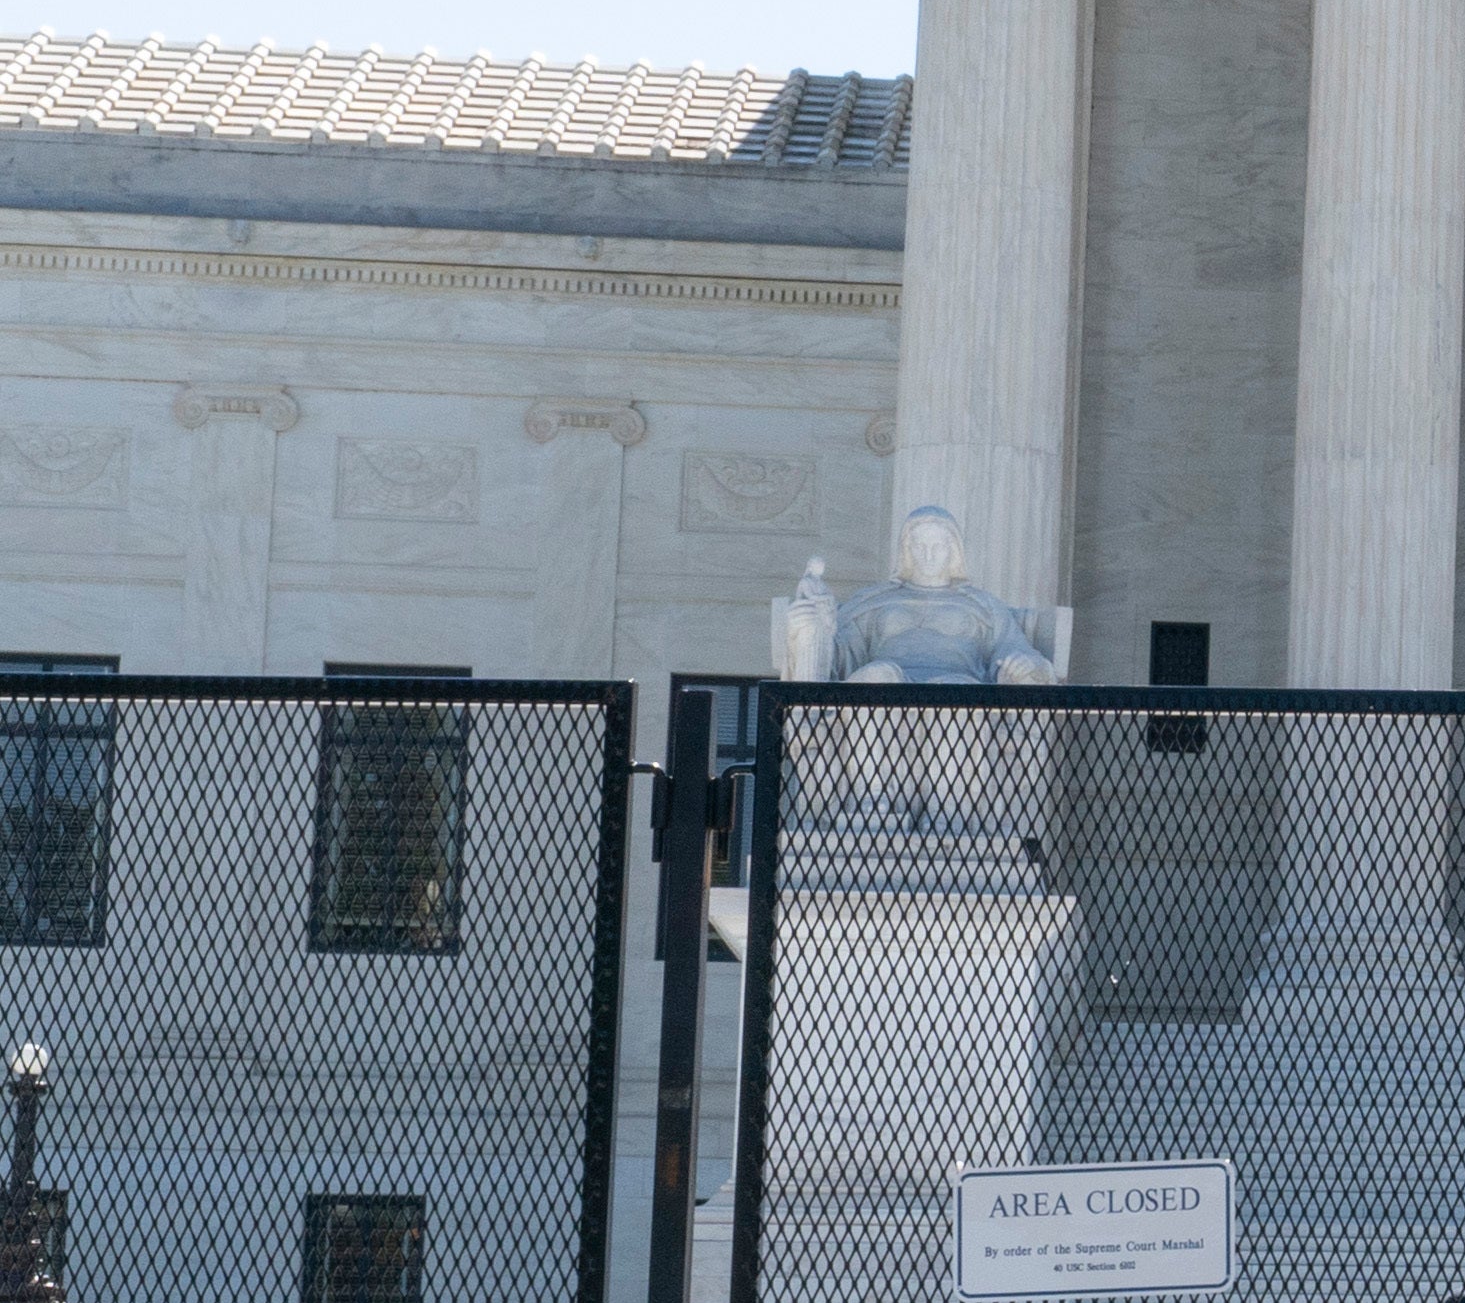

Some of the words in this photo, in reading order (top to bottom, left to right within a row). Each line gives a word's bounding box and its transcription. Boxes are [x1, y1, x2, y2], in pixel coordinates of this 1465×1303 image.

[988, 1191, 1073, 1219] AREA
[1086, 1186, 1201, 1215] CLOSED
[984, 1245, 999, 1259] By
[1003, 1245, 1032, 1257] order
[1036, 1243, 1049, 1255] of
[1054, 1243, 1071, 1255] the
[1075, 1242, 1122, 1256] Supreme
[1126, 1240, 1157, 1252] Court
[1161, 1238, 1205, 1250] Marshal
